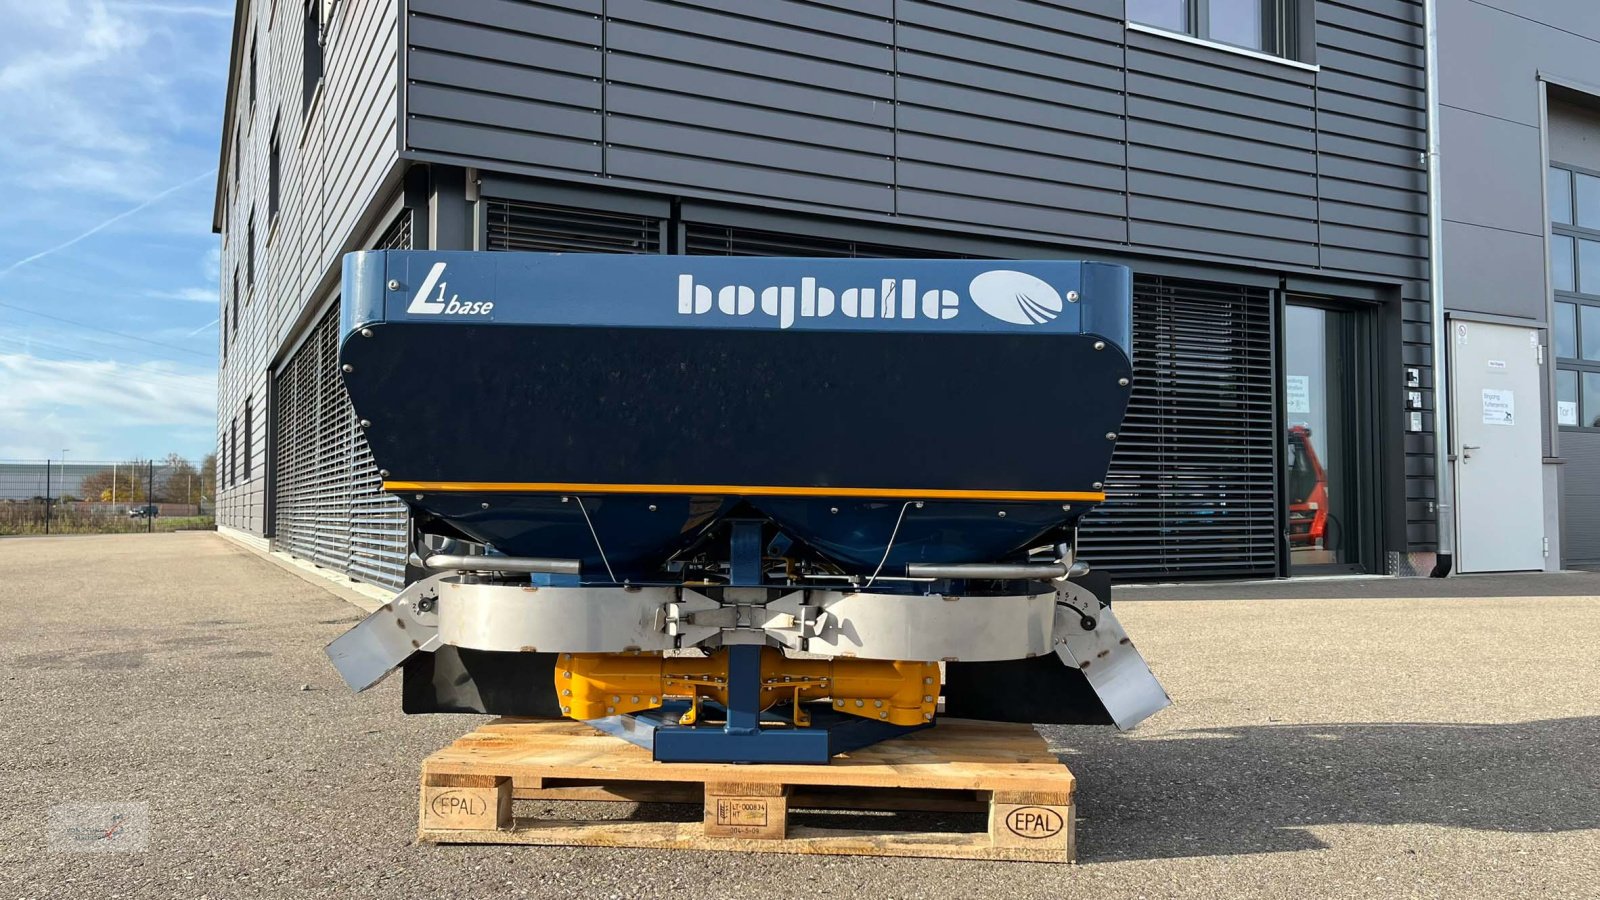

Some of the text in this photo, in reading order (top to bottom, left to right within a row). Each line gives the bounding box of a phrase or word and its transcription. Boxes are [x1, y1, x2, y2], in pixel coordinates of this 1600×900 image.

[445, 294, 494, 315] base
[678, 274, 960, 329] bogballe
[441, 797, 476, 815] EPAL
[1015, 813, 1055, 832] EPAL
